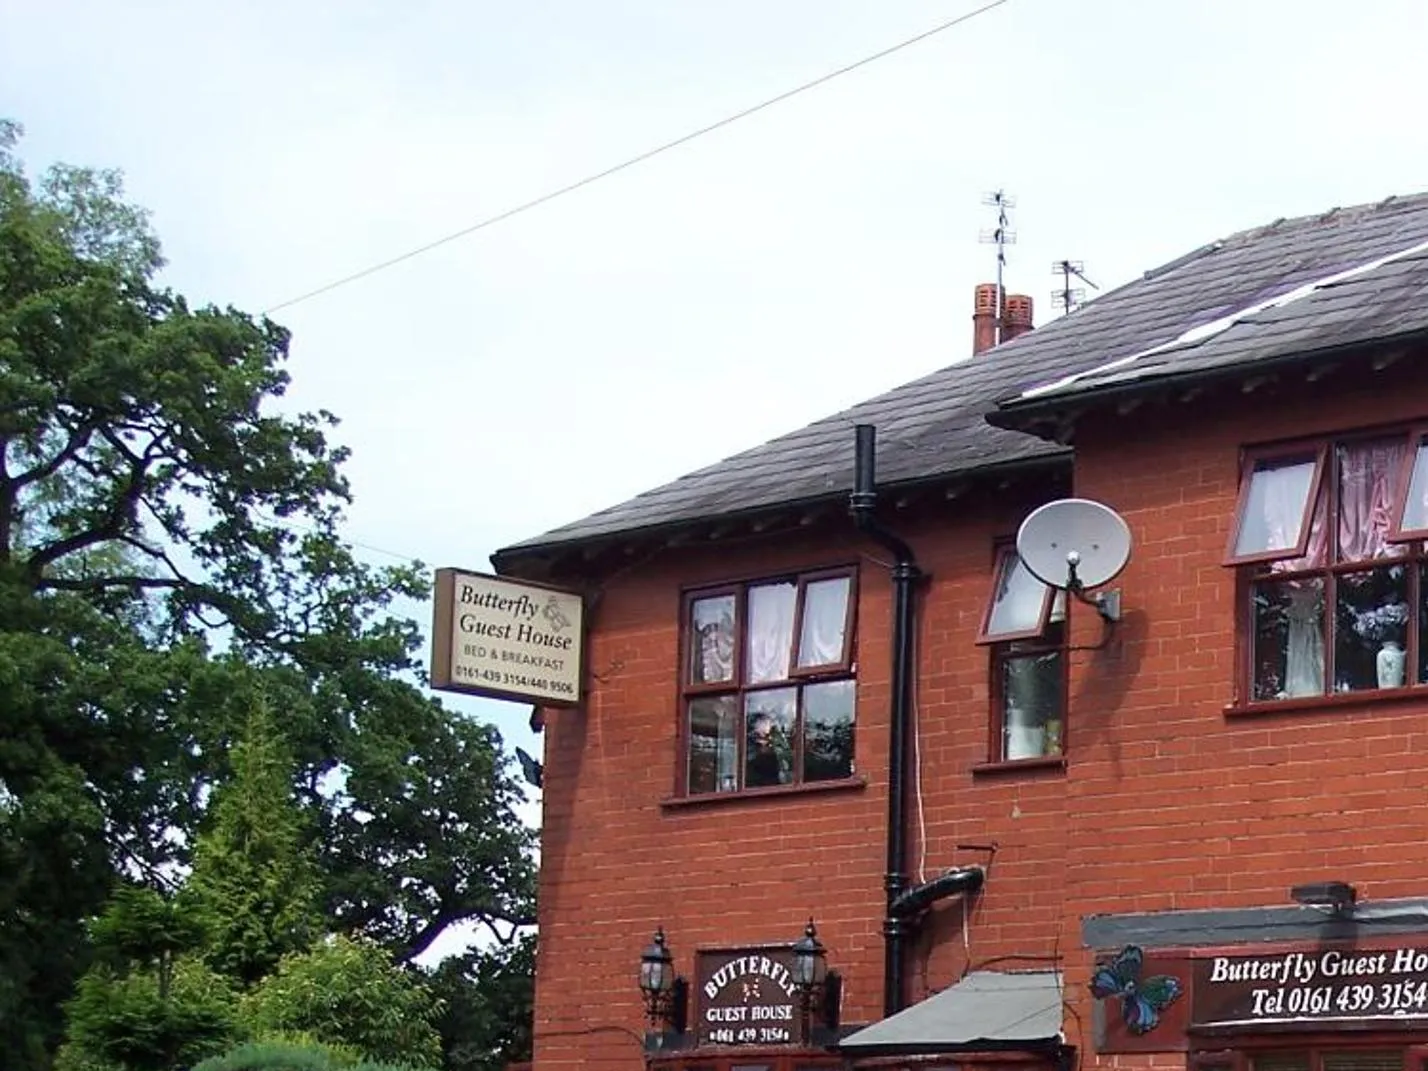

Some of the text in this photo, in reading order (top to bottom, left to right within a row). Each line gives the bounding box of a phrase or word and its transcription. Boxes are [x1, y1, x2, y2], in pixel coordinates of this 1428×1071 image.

[461, 585, 539, 621] Butterfly
[460, 614, 572, 650] Guest House
[464, 644, 564, 671] BED & BREAKFAST
[704, 956, 799, 999] BUTTERFLY
[1210, 953, 1316, 984] Butterfly
[1321, 951, 1385, 977] Guest
[706, 1005, 793, 1022] GUEST HOUSE
[1251, 981, 1428, 1014] Tel 0161 439 3154
[738, 1028, 756, 1042] 439
[760, 1027, 783, 1041] 3154
